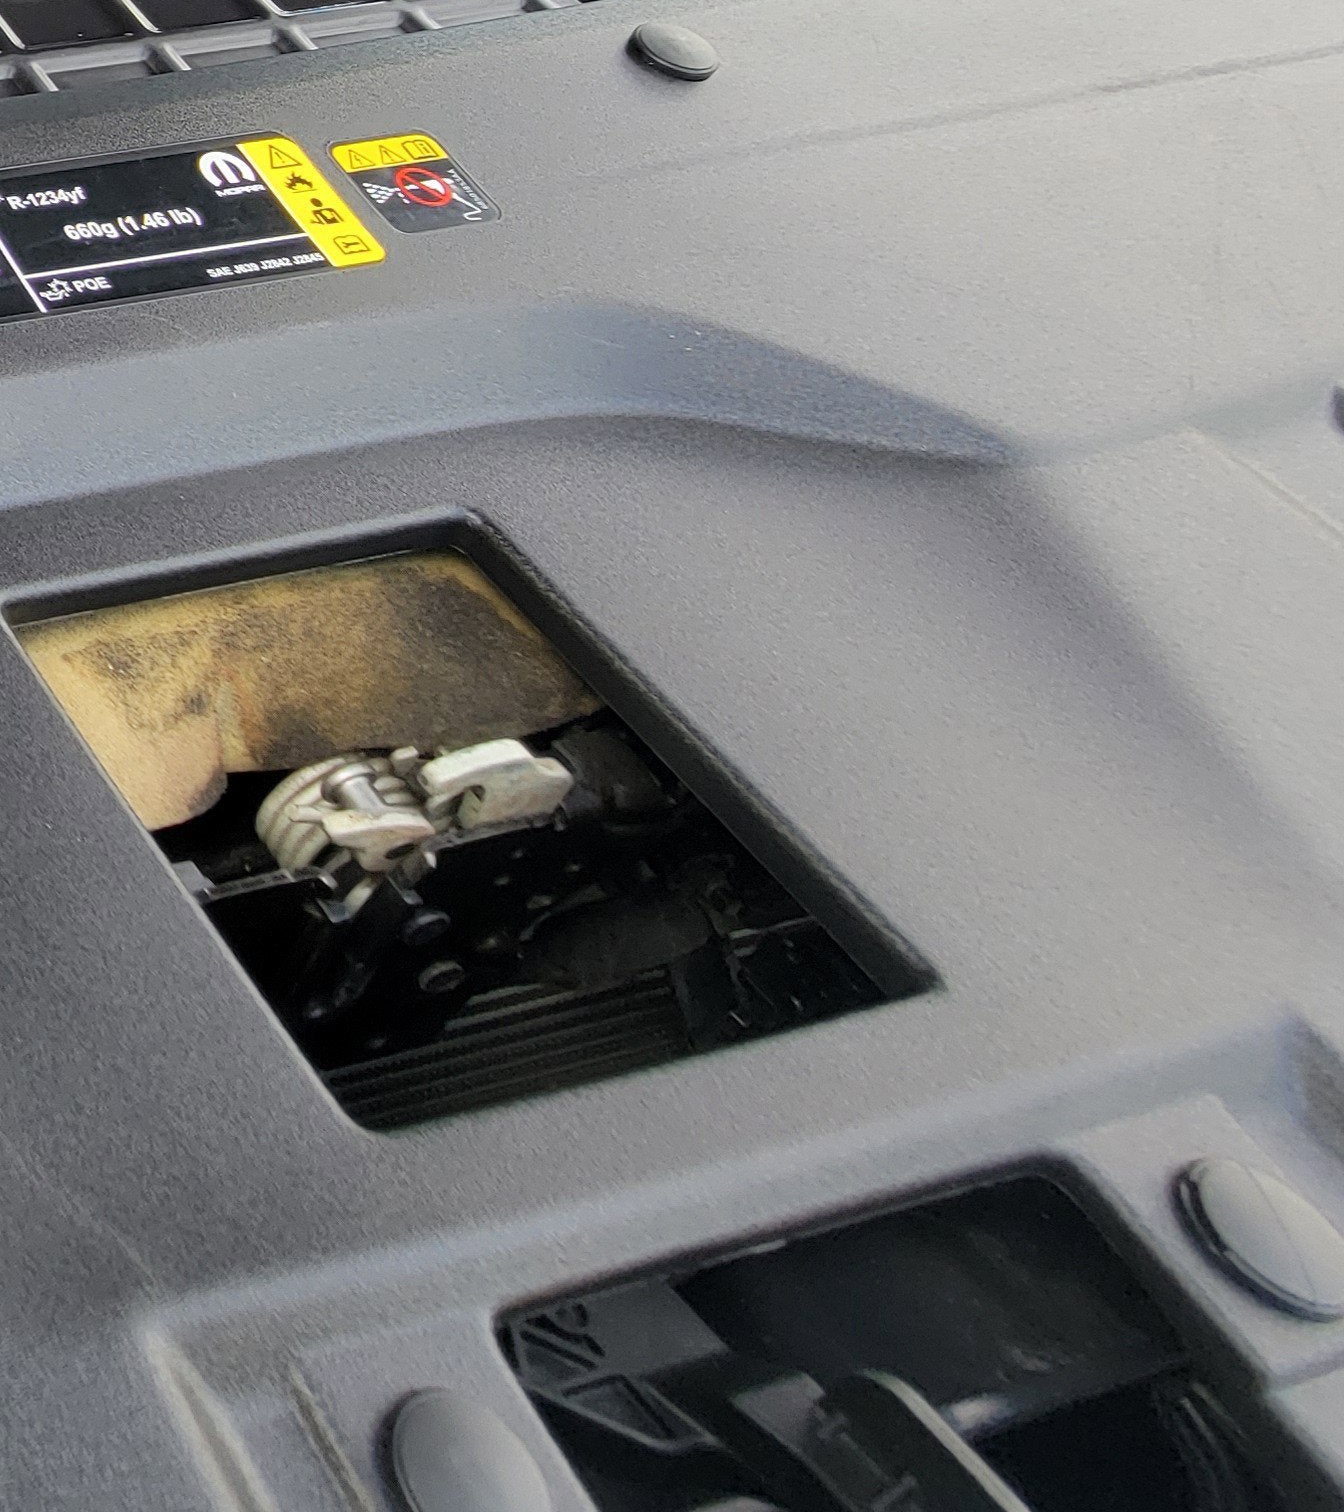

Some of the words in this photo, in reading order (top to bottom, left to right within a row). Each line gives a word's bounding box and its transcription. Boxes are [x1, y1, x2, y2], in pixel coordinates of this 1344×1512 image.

[6, 186, 87, 210] R-1234yf
[214, 184, 266, 197] MOPAR
[63, 221, 119, 240] 660g
[116, 211, 169, 235] (1.46
[167, 207, 203, 226] lb)
[206, 266, 234, 278] SAE
[72, 276, 112, 292] POE
